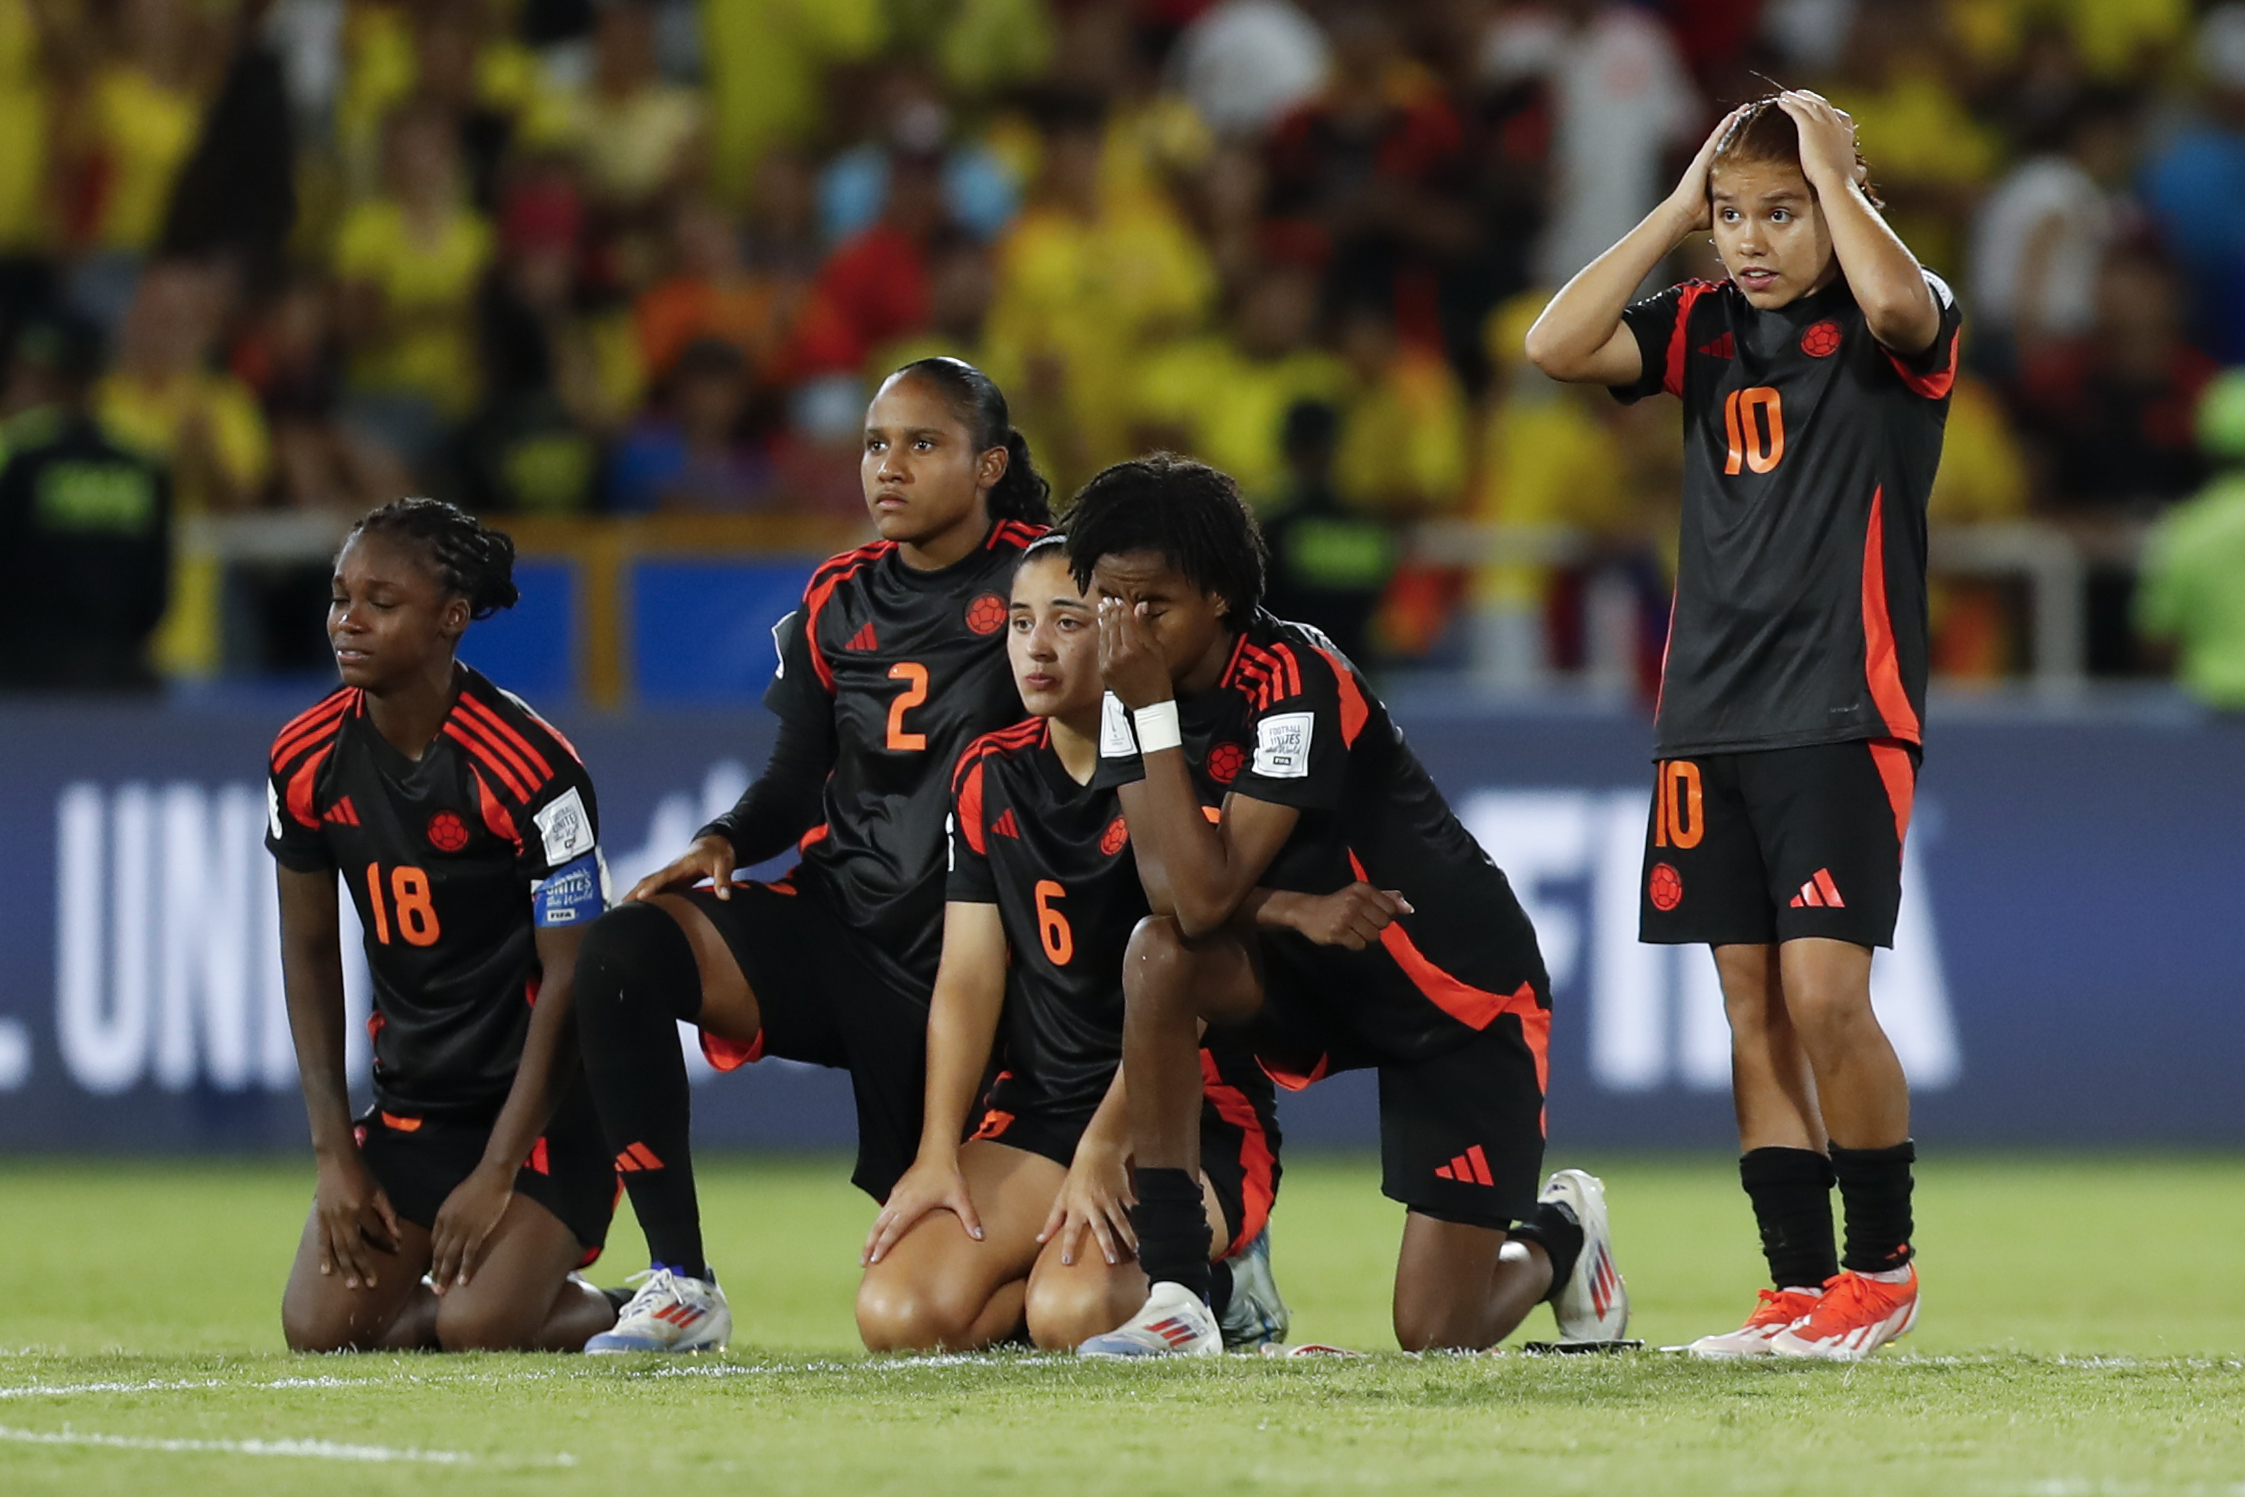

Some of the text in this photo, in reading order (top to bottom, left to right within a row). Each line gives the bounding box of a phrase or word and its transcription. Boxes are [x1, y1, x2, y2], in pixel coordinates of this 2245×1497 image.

[1724, 386, 1784, 475] 10
[887, 661, 928, 750] 2
[1269, 725, 1301, 736] FOOTBALL
[1655, 760, 1704, 849] 10
[366, 861, 440, 947] 18
[546, 878, 592, 895] UNITES
[550, 911, 573, 919] FIFA
[1035, 879, 1073, 966] 6
